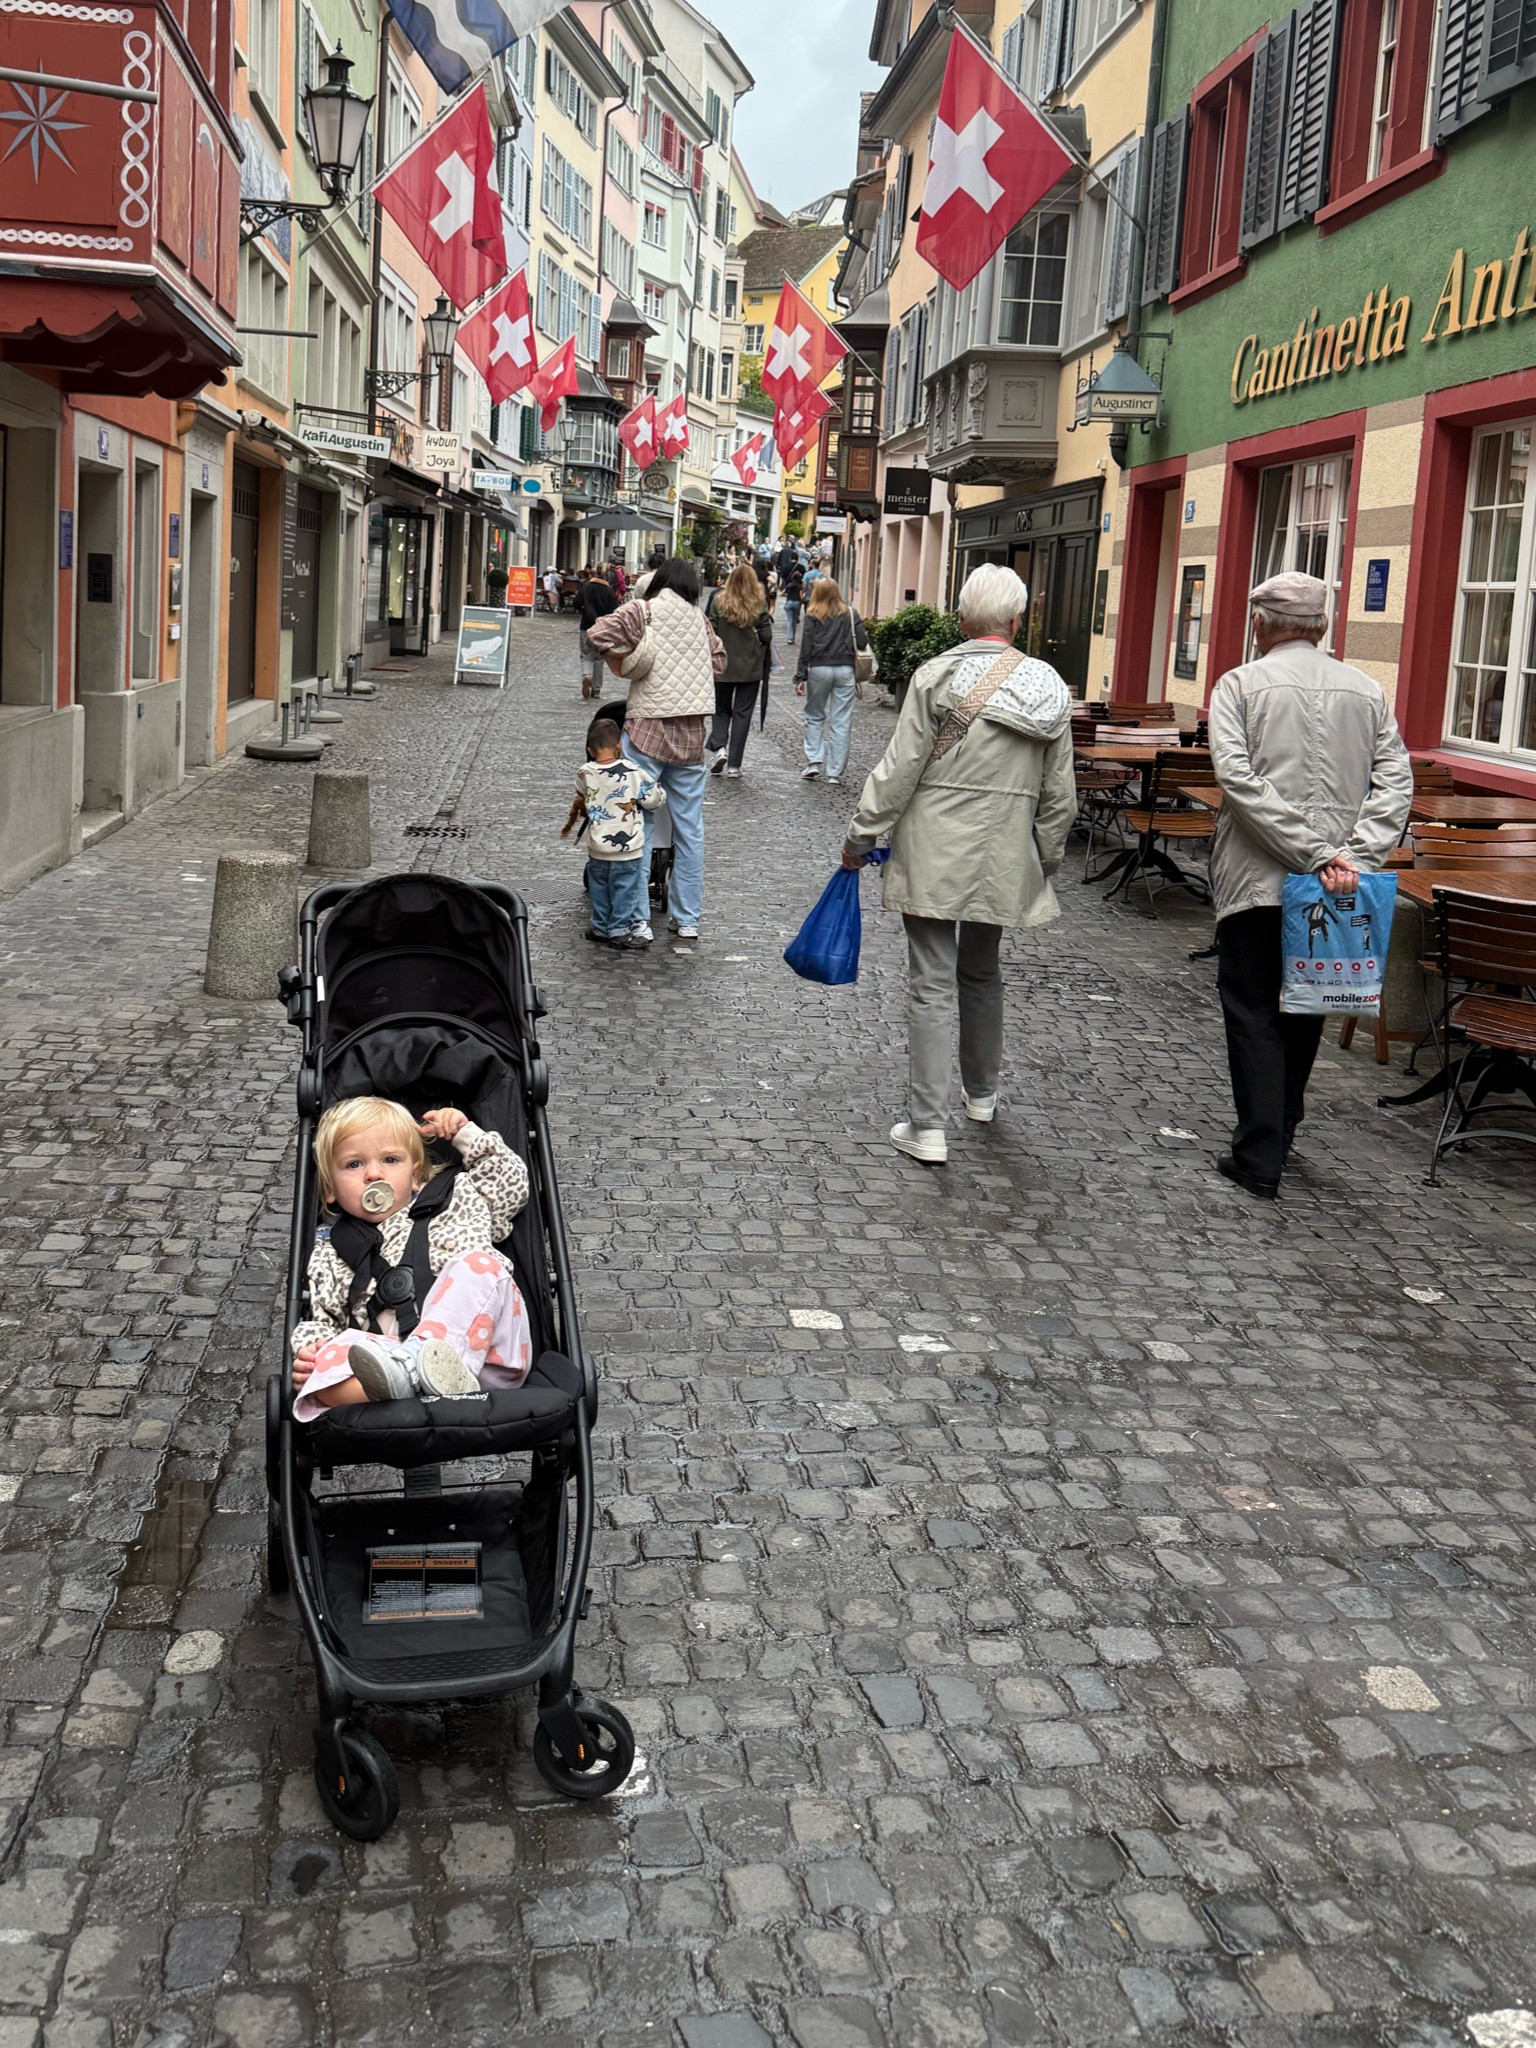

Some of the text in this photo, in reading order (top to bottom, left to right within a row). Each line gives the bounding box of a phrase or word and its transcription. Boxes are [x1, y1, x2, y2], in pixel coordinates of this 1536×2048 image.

[1230, 283, 1411, 404] Cantinetta
[1093, 396, 1154, 412] Augustiner
[425, 434, 457, 448] kybun
[426, 454, 455, 468] Joya
[887, 494, 929, 504] meister
